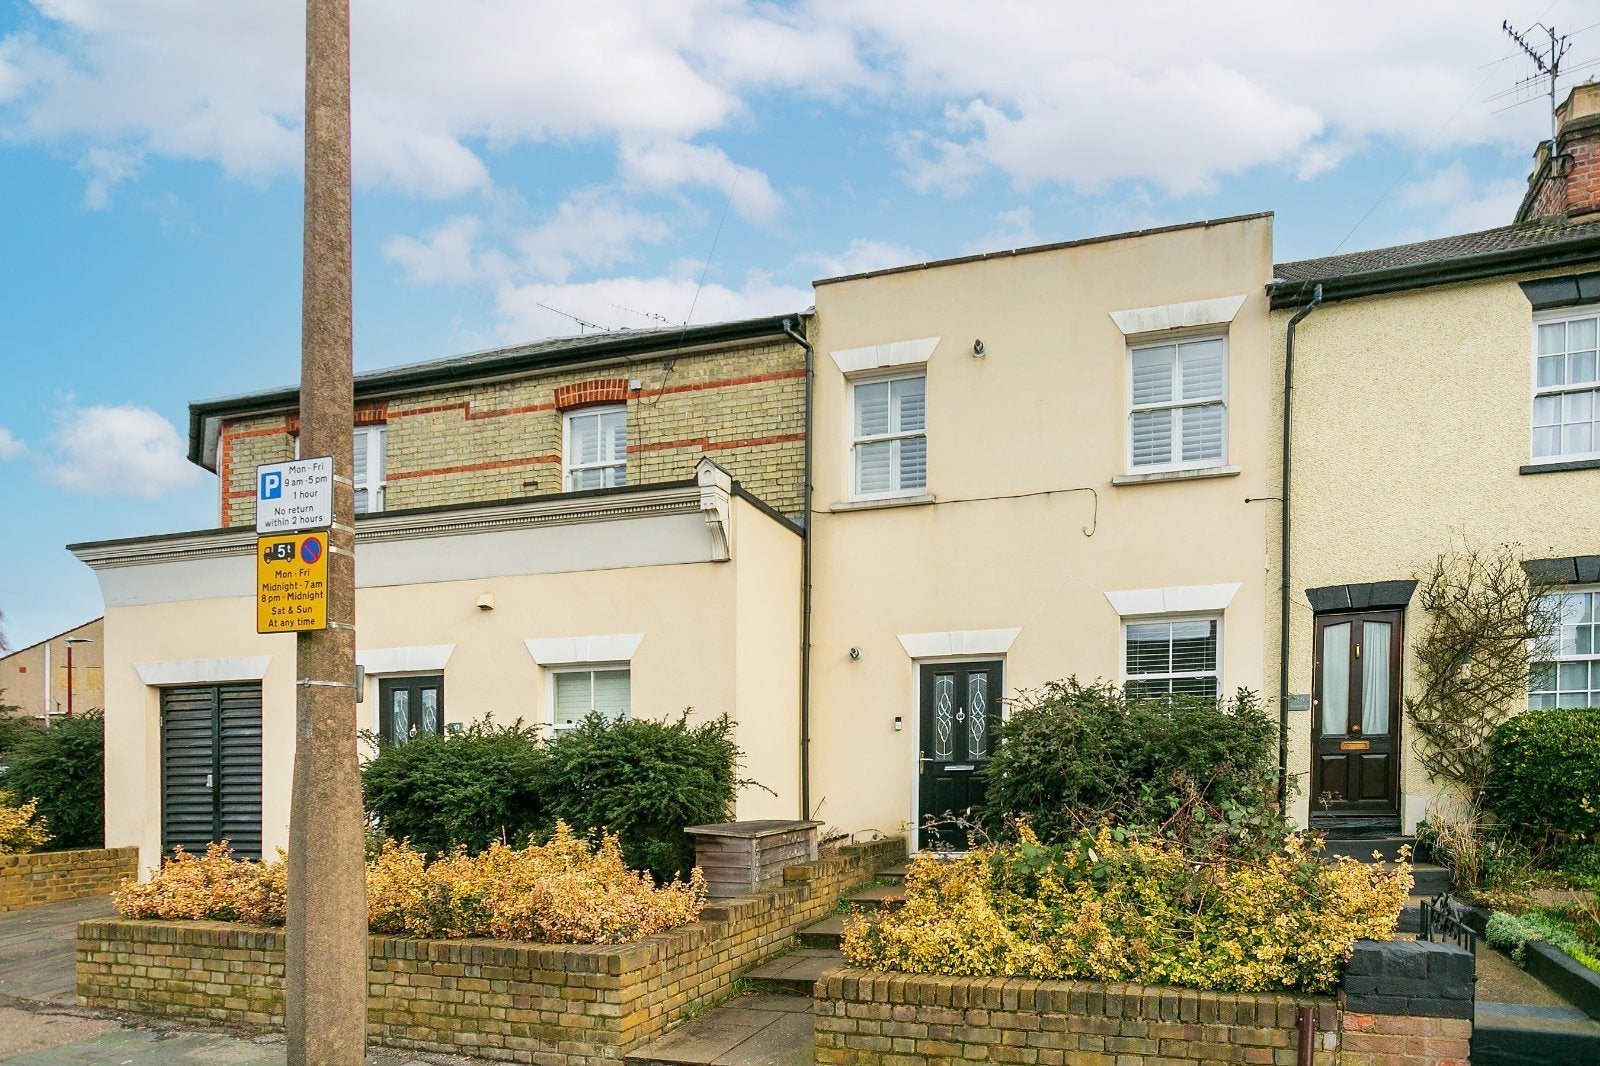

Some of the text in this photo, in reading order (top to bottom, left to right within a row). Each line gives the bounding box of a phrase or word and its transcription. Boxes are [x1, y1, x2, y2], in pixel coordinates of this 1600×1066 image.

[289, 466, 306, 474] Mon
[313, 462, 324, 471] Fri
[265, 474, 279, 498] P
[293, 490, 318, 499] 1 hour
[274, 505, 314, 515] No return
[265, 515, 323, 527] within 2 hours
[275, 570, 292, 578] Mon
[299, 568, 310, 577] Fri
[262, 582, 298, 592] Midnight
[287, 590, 323, 601] Midnight
[271, 605, 312, 615] Sat & Sun
[268, 618, 315, 627] At any time
